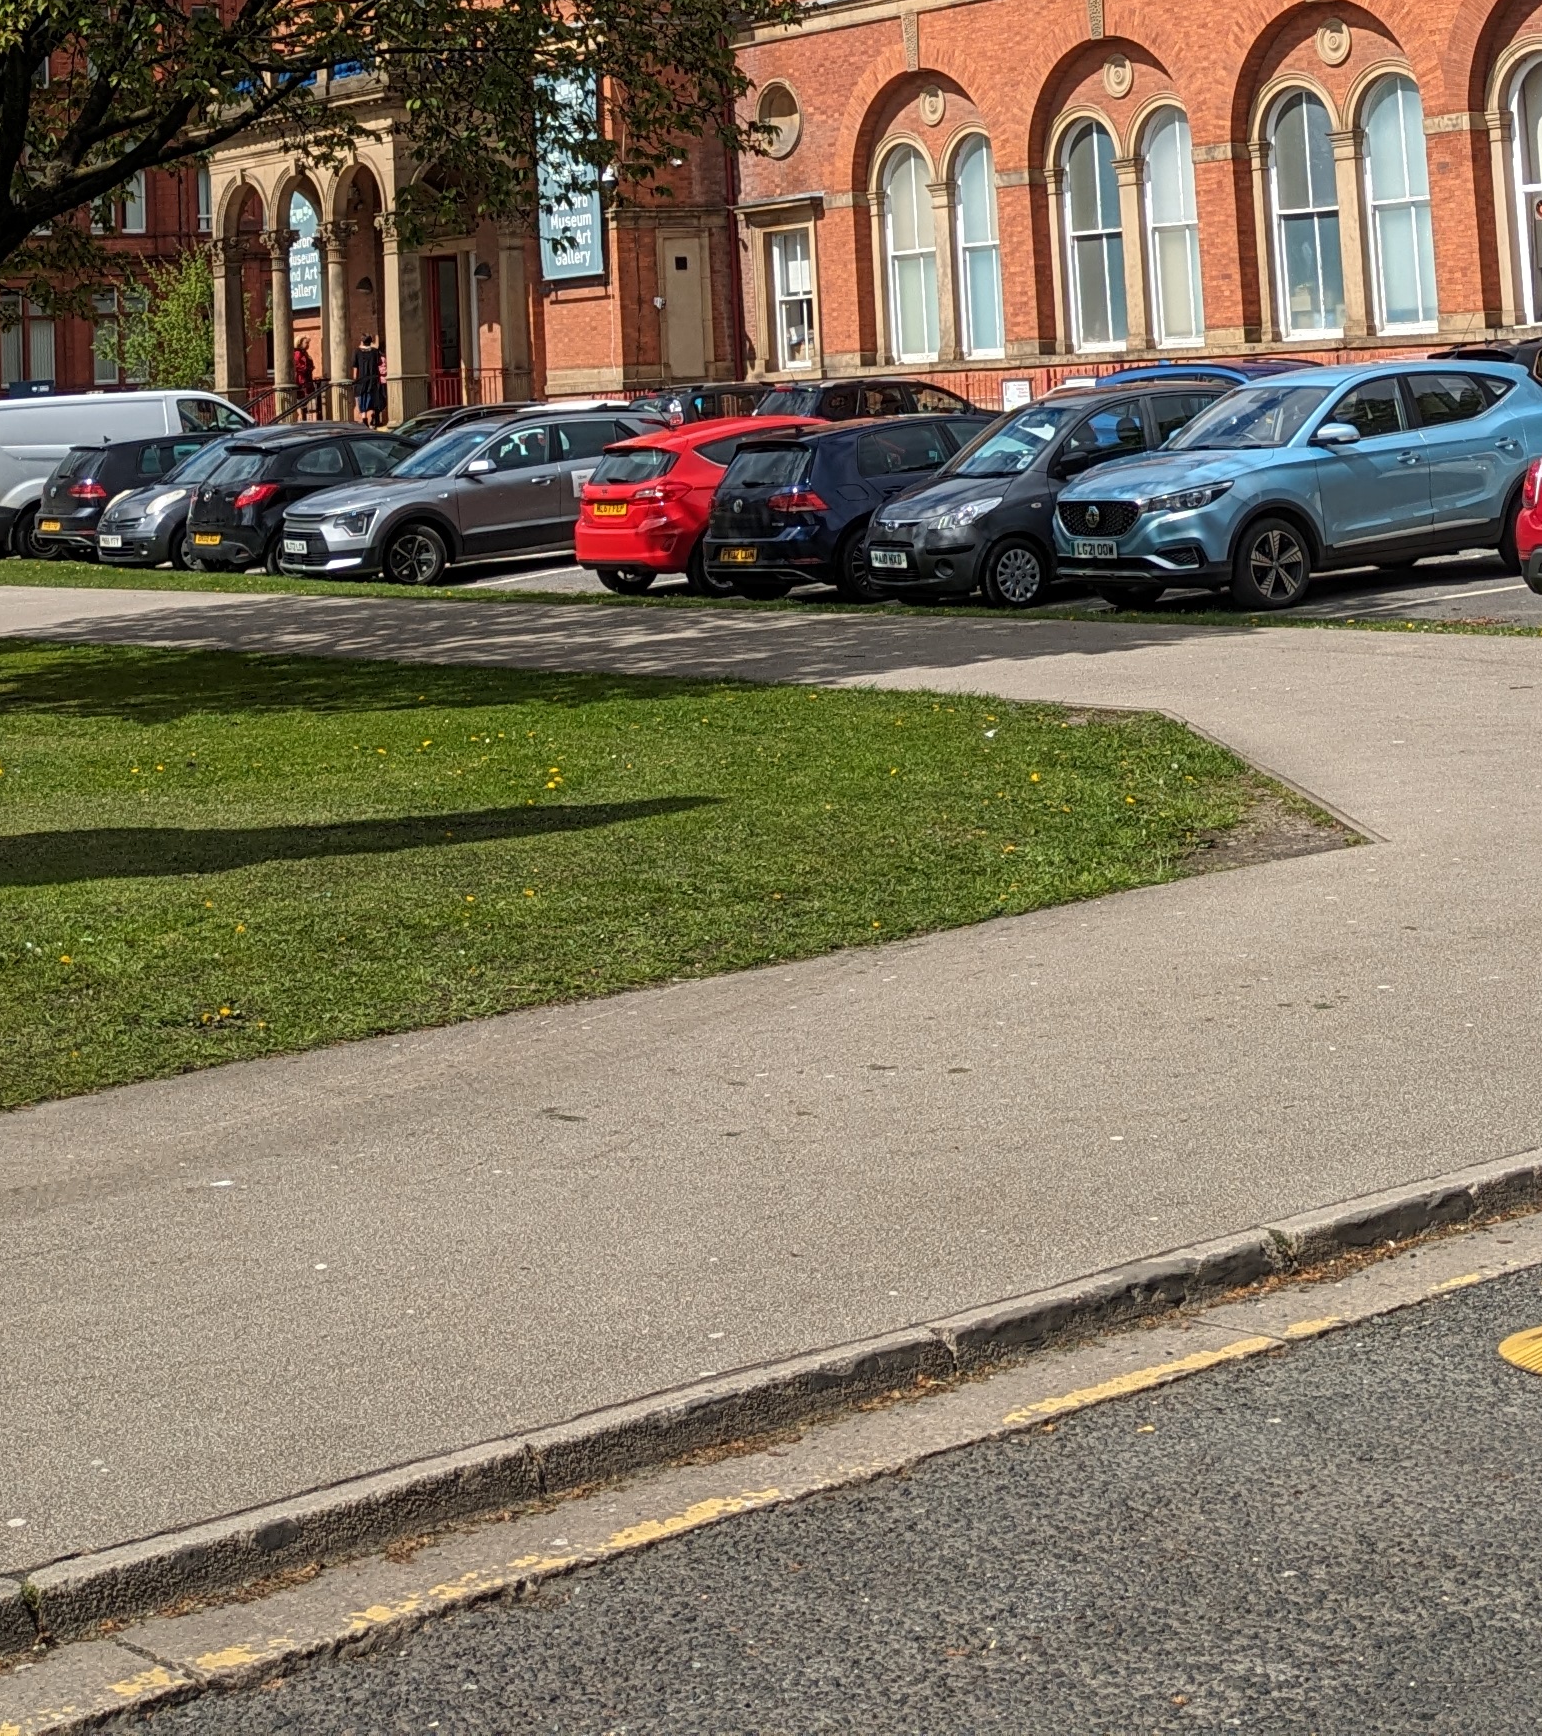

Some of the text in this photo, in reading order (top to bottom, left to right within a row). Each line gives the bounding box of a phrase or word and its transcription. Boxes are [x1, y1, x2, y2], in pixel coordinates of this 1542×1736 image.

[550, 213, 593, 231] Museum
[575, 229, 592, 245] Art
[289, 253, 319, 266] useum
[304, 265, 318, 281] Art
[1076, 542, 1096, 556] LG21
